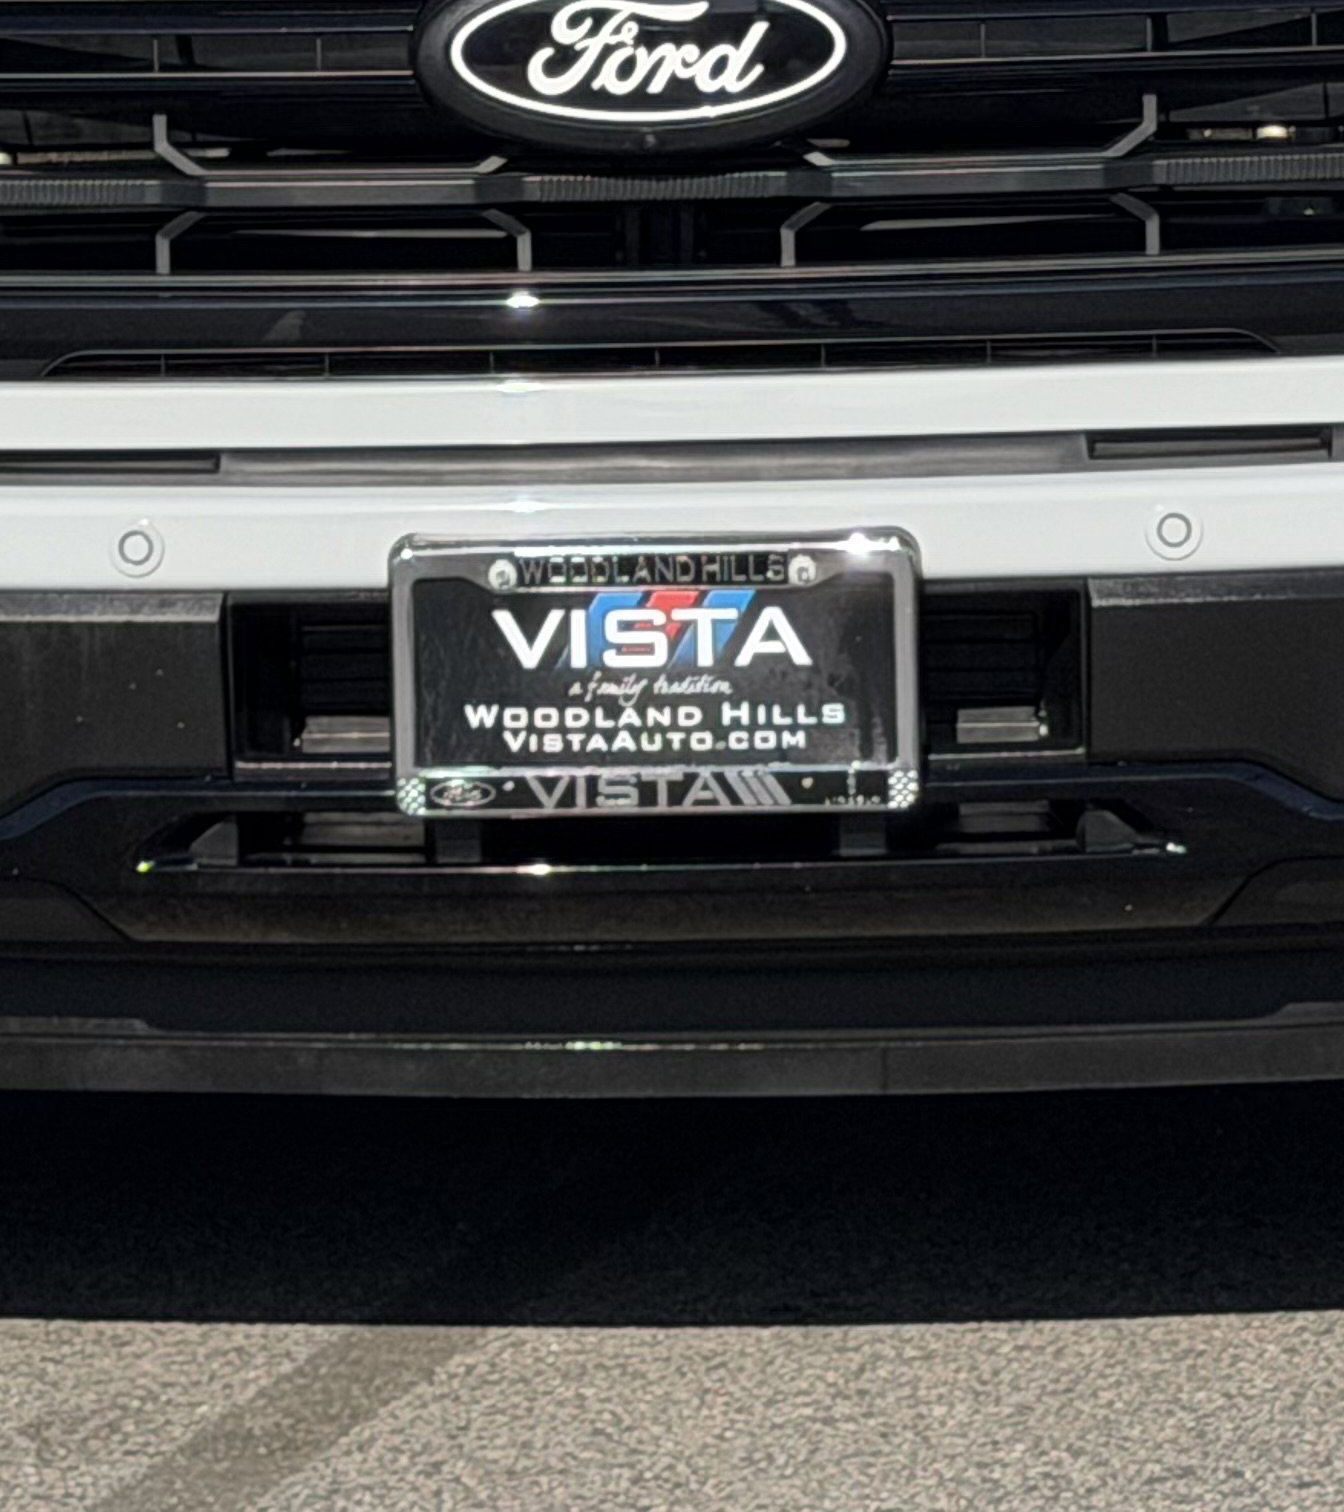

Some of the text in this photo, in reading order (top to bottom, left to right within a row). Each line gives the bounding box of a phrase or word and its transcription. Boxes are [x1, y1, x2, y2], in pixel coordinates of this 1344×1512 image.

[520, 552, 785, 585] WOODLAND HILLS
[492, 605, 813, 670] VISTA
[721, 701, 846, 727] HILLS
[523, 771, 731, 808] VISTA
